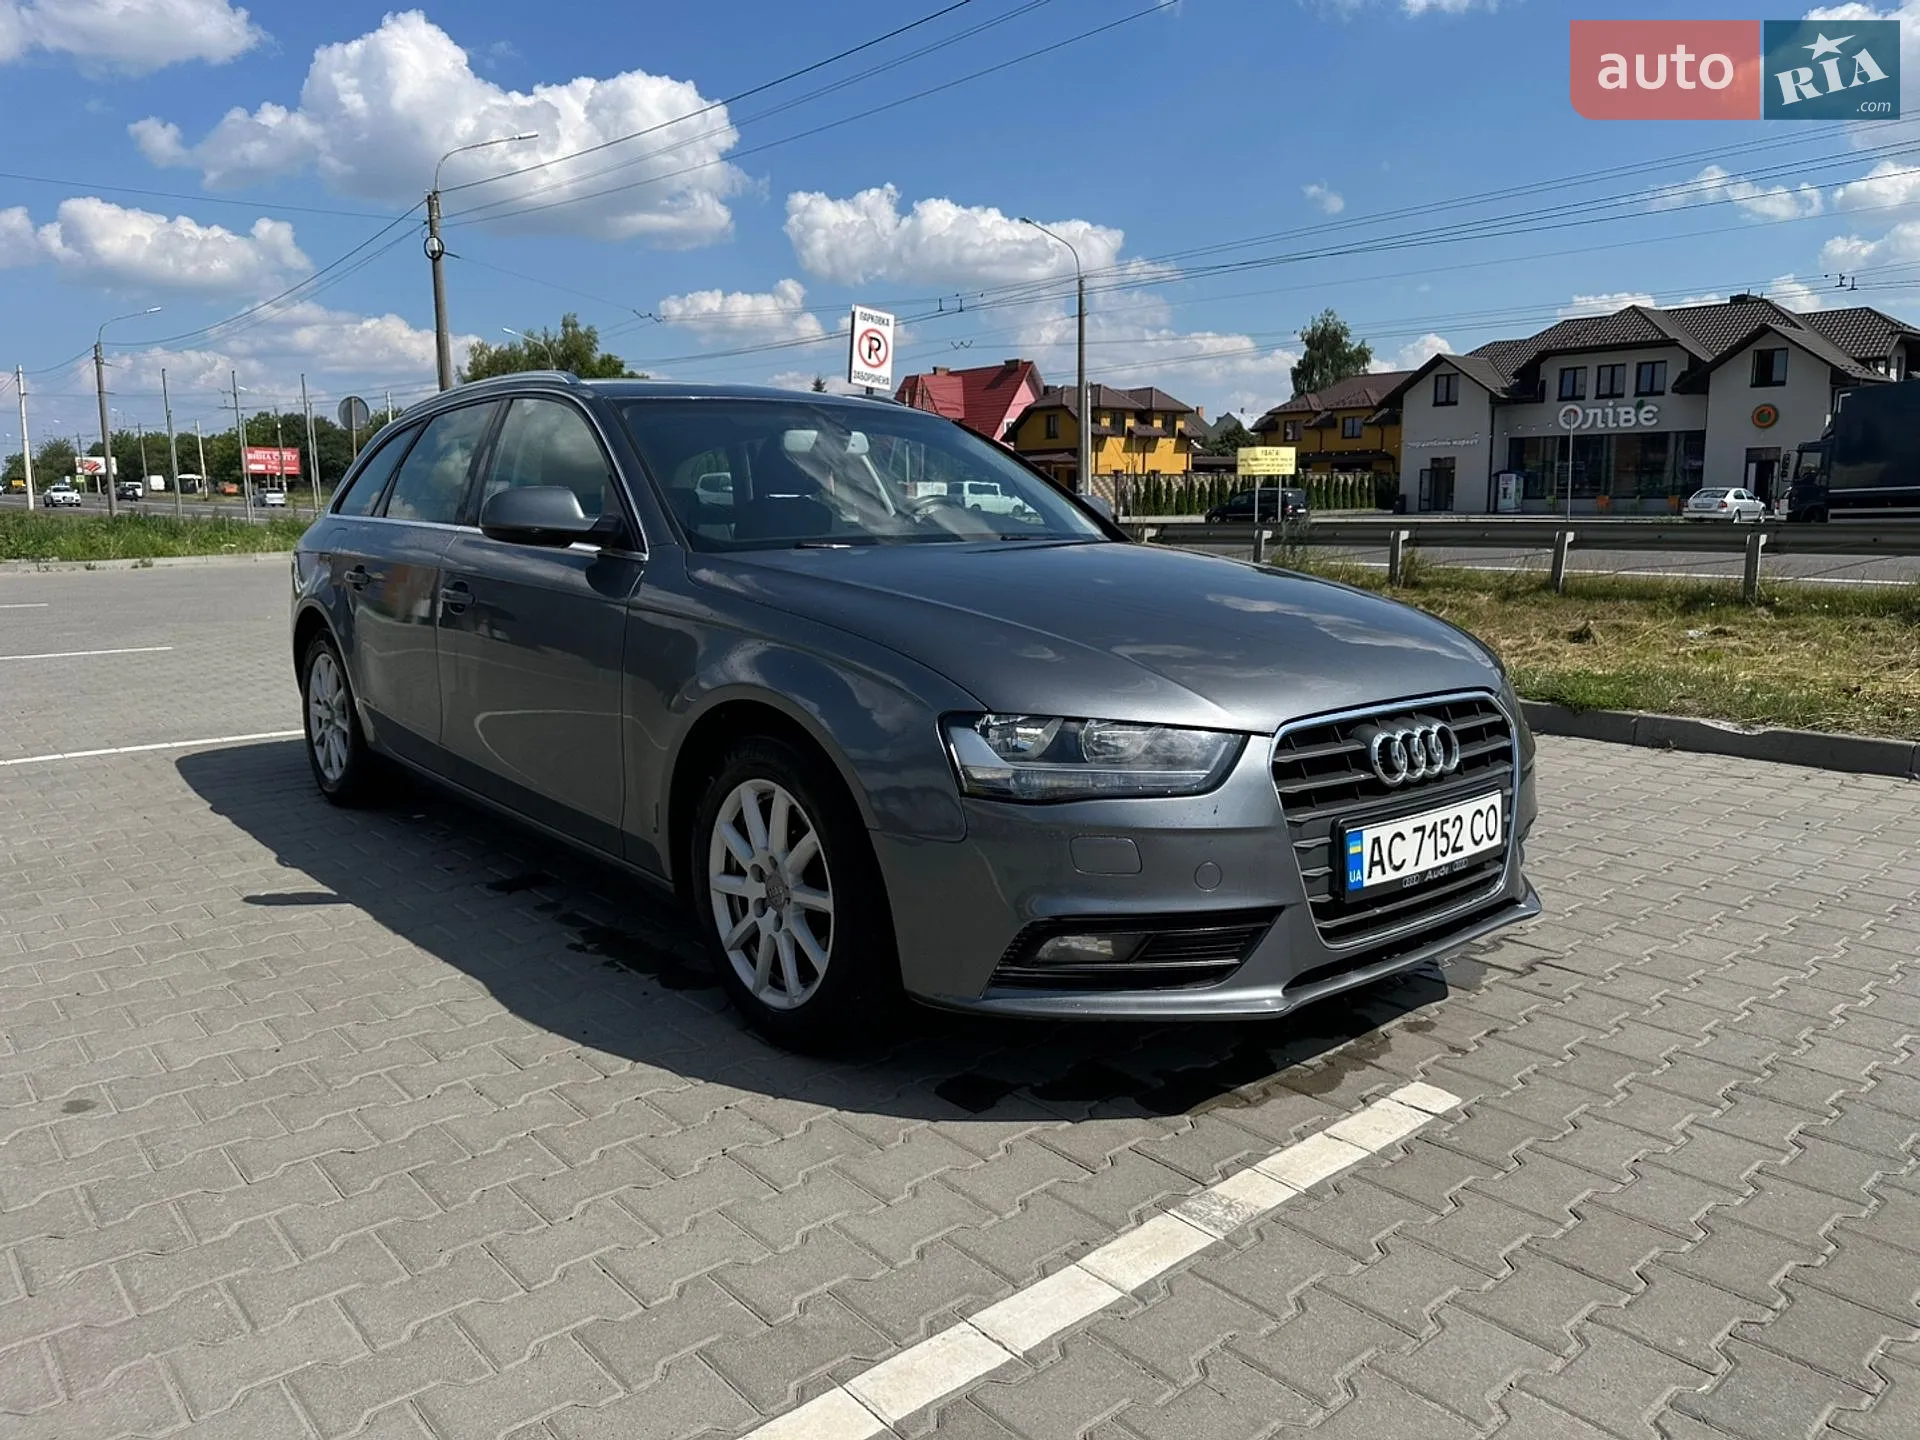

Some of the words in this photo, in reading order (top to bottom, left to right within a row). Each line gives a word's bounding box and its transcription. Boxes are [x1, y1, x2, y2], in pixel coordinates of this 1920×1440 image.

[859, 311, 890, 327] ПАРКОВКА
[1366, 831, 1407, 880] AC
[1412, 814, 1464, 867] 7152
[1470, 804, 1498, 847] CO
[1349, 869, 1363, 883] UA
